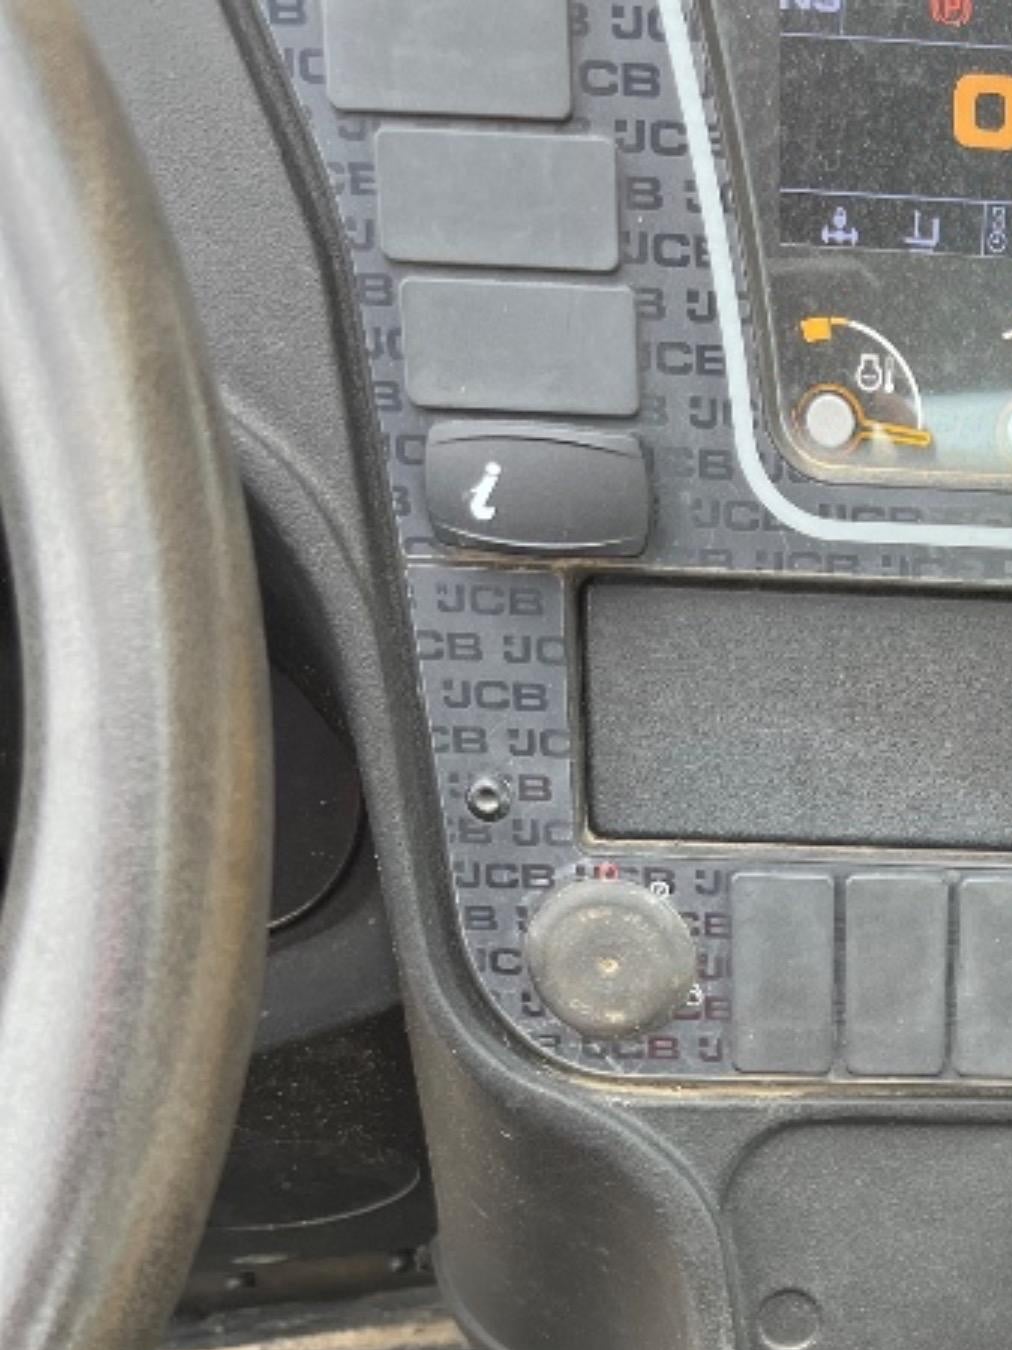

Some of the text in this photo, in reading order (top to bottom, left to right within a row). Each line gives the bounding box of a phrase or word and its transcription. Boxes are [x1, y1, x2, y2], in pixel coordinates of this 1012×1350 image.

[579, 60, 661, 97] CB
[436, 584, 544, 616] JCB
[416, 630, 568, 666] CB JC
[443, 680, 549, 712] JCB
[508, 728, 573, 758] JC
[512, 818, 574, 847] JC
[454, 861, 556, 889] JCB
